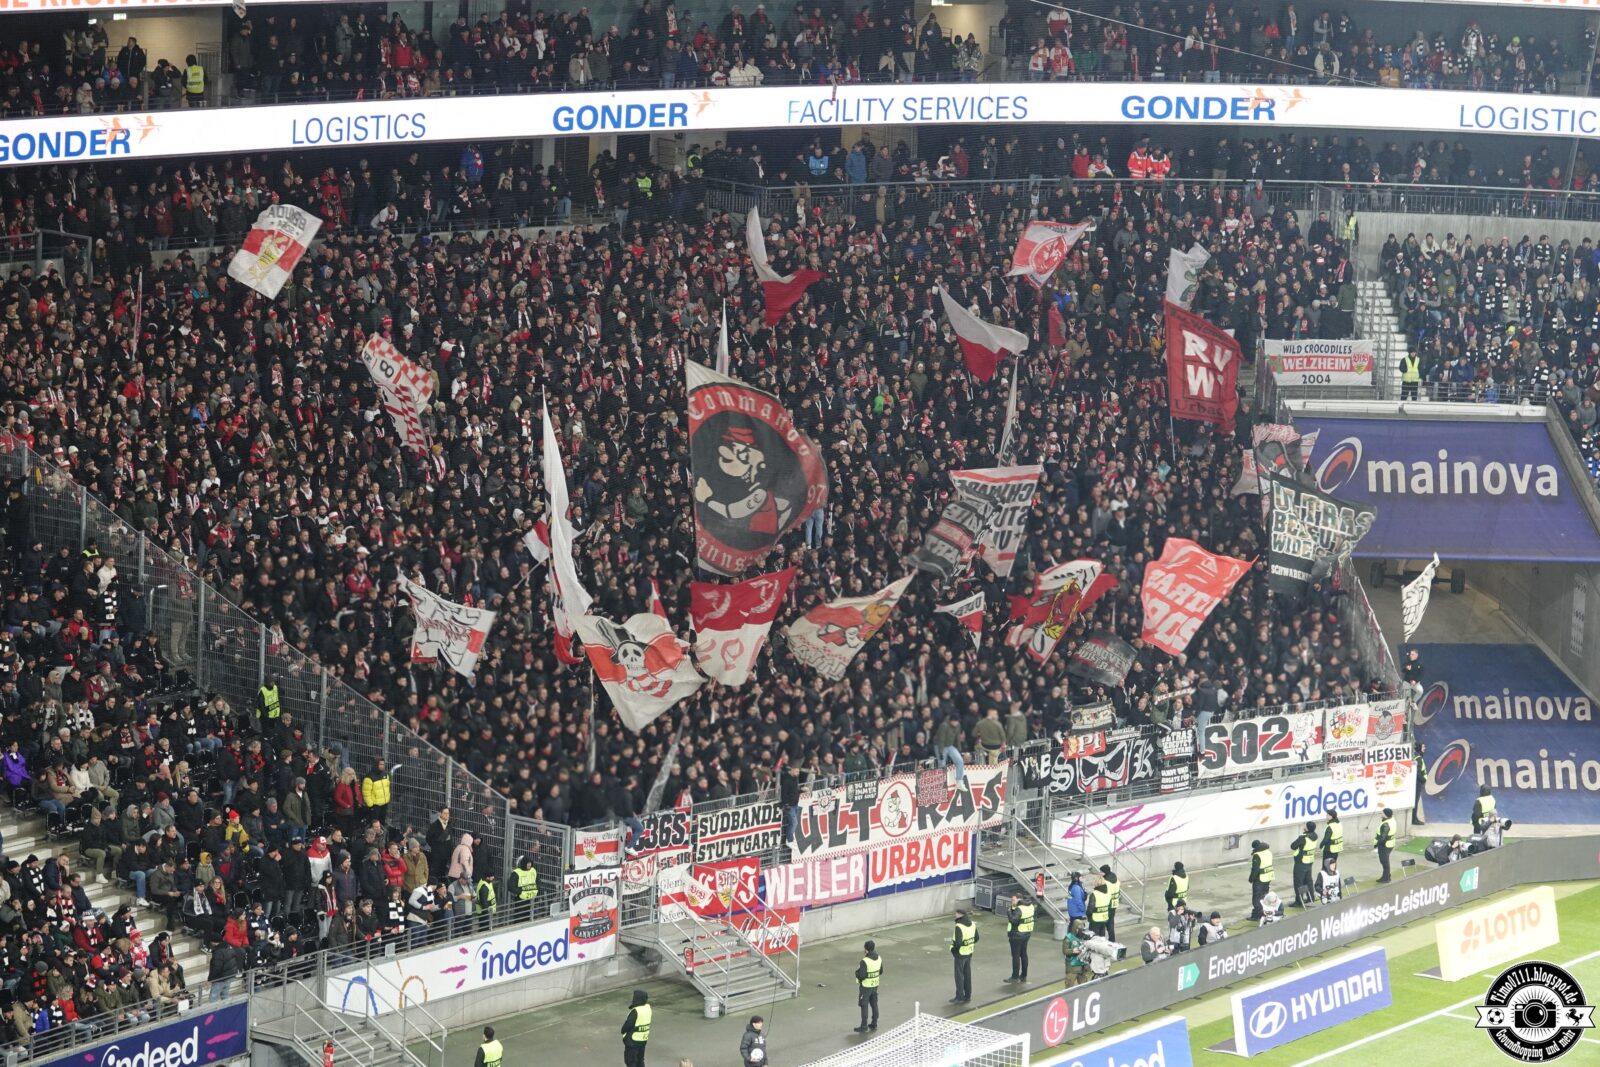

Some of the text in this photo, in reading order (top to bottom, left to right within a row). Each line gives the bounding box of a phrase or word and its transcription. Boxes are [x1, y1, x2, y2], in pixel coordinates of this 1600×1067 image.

[553, 102, 689, 132] GONDER
[788, 95, 1028, 126] FACILITY SERVICES
[1120, 95, 1276, 122] GONDER
[1459, 104, 1600, 134] LOGISTIC
[292, 113, 426, 145] LOGISTICS
[1283, 344, 1352, 355] WILD CROCODILES
[1283, 357, 1351, 370] WELZHEIM
[1301, 374, 1331, 384] 2004
[1368, 449, 1559, 497] mainova
[1453, 688, 1592, 721] mainova
[1367, 747, 1410, 763] HESSEN
[1475, 748, 1600, 791] maino
[699, 803, 783, 836] SÜDBANDE
[699, 830, 782, 862] STUTTGART
[871, 831, 969, 884] URBACH
[763, 854, 865, 908] WEILER
[1485, 902, 1541, 945] LOTTO
[476, 928, 569, 981] indeed
[1208, 924, 1319, 980] Energiesparende
[1072, 991, 1100, 1032] LG
[1291, 967, 1383, 1024] HYUNDAI
